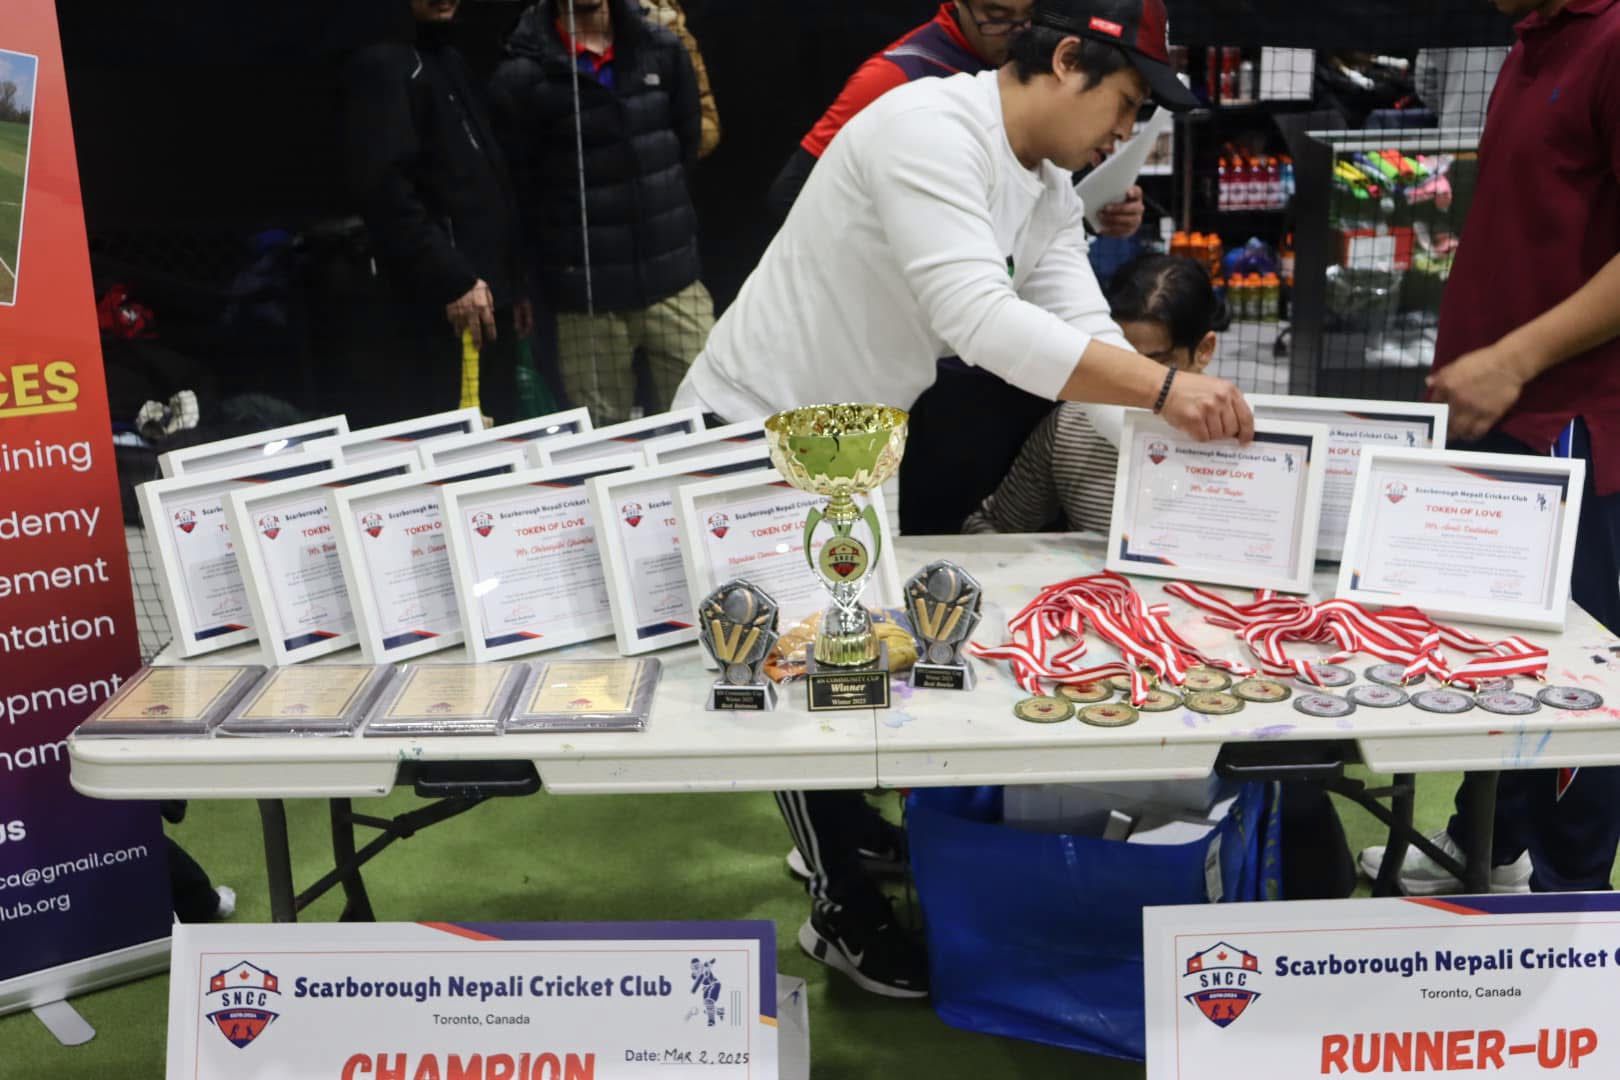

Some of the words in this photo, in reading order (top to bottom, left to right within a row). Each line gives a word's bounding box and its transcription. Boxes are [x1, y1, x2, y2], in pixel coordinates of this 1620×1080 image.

[1184, 465, 1214, 475] TOKEN
[1215, 468, 1227, 477] OF
[1228, 470, 1254, 480] LOVE
[1425, 503, 1458, 516] TOKEN
[1460, 507, 1473, 517] OF
[1475, 509, 1503, 519] LOVE
[301, 525, 331, 538] TOKEN
[404, 524, 433, 537] TOKEN
[515, 525, 546, 537] TOKEN
[548, 521, 559, 531] OF
[561, 518, 585, 529] LOVE
[751, 525, 780, 538] TOKEN
[781, 522, 794, 532] OF
[831, 682, 866, 693] Winner
[0, 673, 121, 724] pment
[1275, 951, 1428, 978] Scarborough
[1435, 948, 1513, 976] Nepali
[1520, 947, 1608, 969] Cricket
[1200, 971, 1247, 988] SNCC
[294, 976, 440, 1002] Scarborough
[448, 975, 523, 1001] Nepali
[529, 975, 614, 997] Cricket
[620, 975, 672, 997] Club
[1420, 987, 1472, 999] Toronto,
[1475, 986, 1521, 998] Canada
[221, 991, 268, 1007] SNCC
[433, 1014, 483, 1027] Toronto,
[485, 1014, 530, 1025] Canada
[624, 1049, 661, 1062] Date:
[718, 1050, 750, 1065] 2025
[1320, 1028, 1598, 1074] RUNNER-UP
